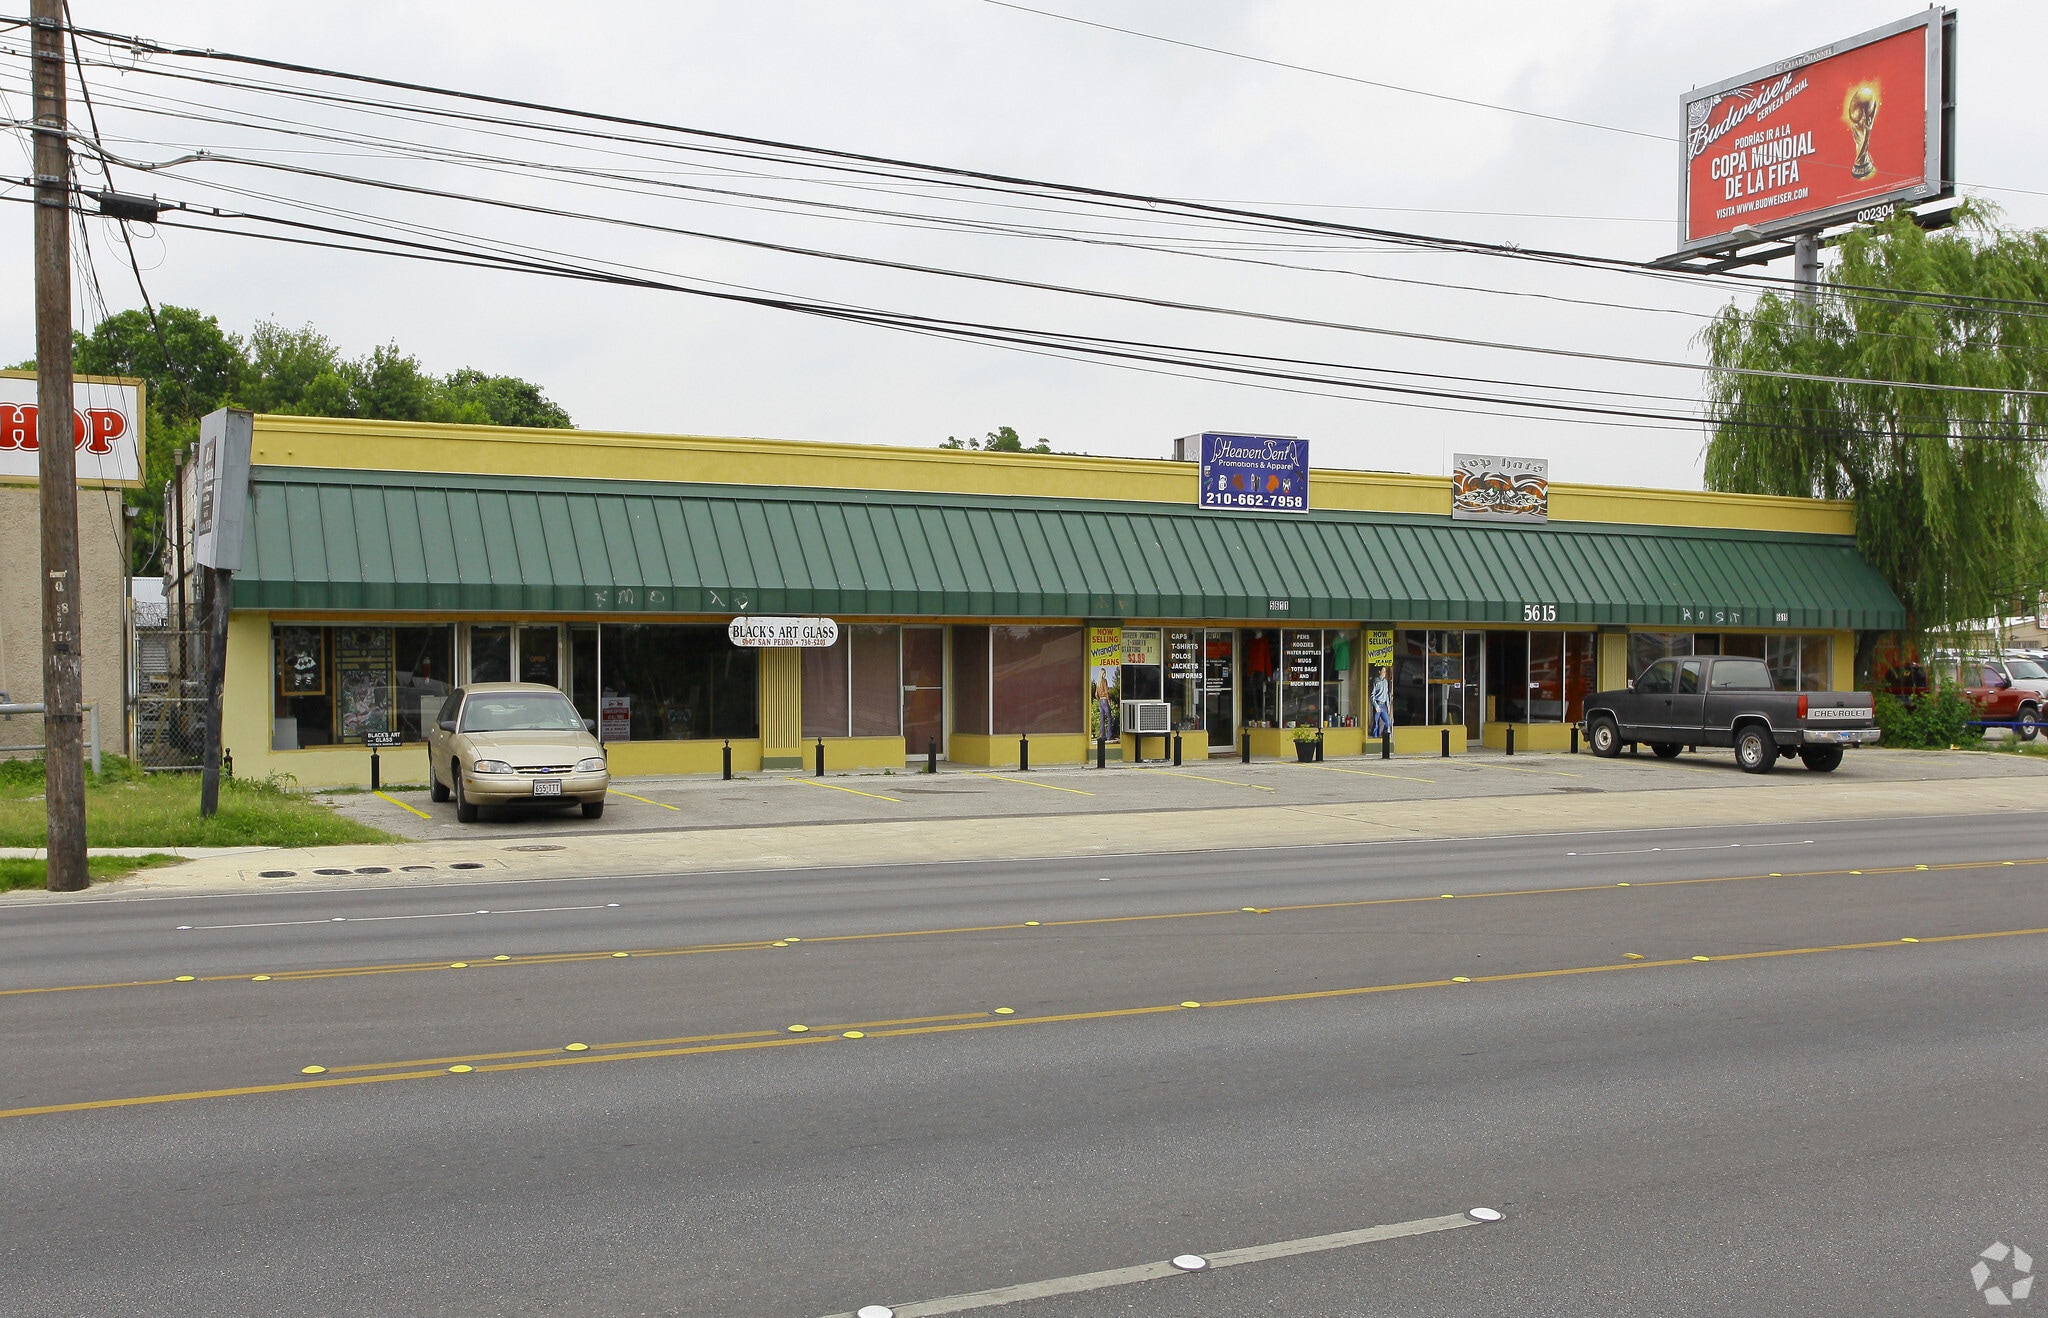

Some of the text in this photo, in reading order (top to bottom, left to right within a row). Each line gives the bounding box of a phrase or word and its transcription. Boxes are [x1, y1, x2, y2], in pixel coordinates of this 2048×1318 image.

[1757, 78, 1809, 122] CERVEZA OFICIAL
[1687, 72, 1793, 160] Budweiser
[1734, 124, 1791, 150] PODRÍAS IR A LA
[1711, 131, 1816, 180] COPA MUNDIAL
[1725, 160, 1800, 200] DE LA FIFA
[1716, 187, 1809, 220] VISITA WWW.BUDWEISER.COM
[1857, 203, 1895, 222] 002304
[1217, 440, 1289, 460] Heaven Sent
[1218, 459, 1259, 468] Promotions
[1206, 492, 1303, 507] 210-662-7958
[1523, 604, 1556, 622] 5615
[733, 625, 835, 639] BLACK'S ART GLASS
[1368, 637, 1392, 645] SELLING
[1091, 643, 1120, 657] Wrangler
[1100, 658, 1120, 666] JEANS
[1171, 662, 1199, 670] JACKETS
